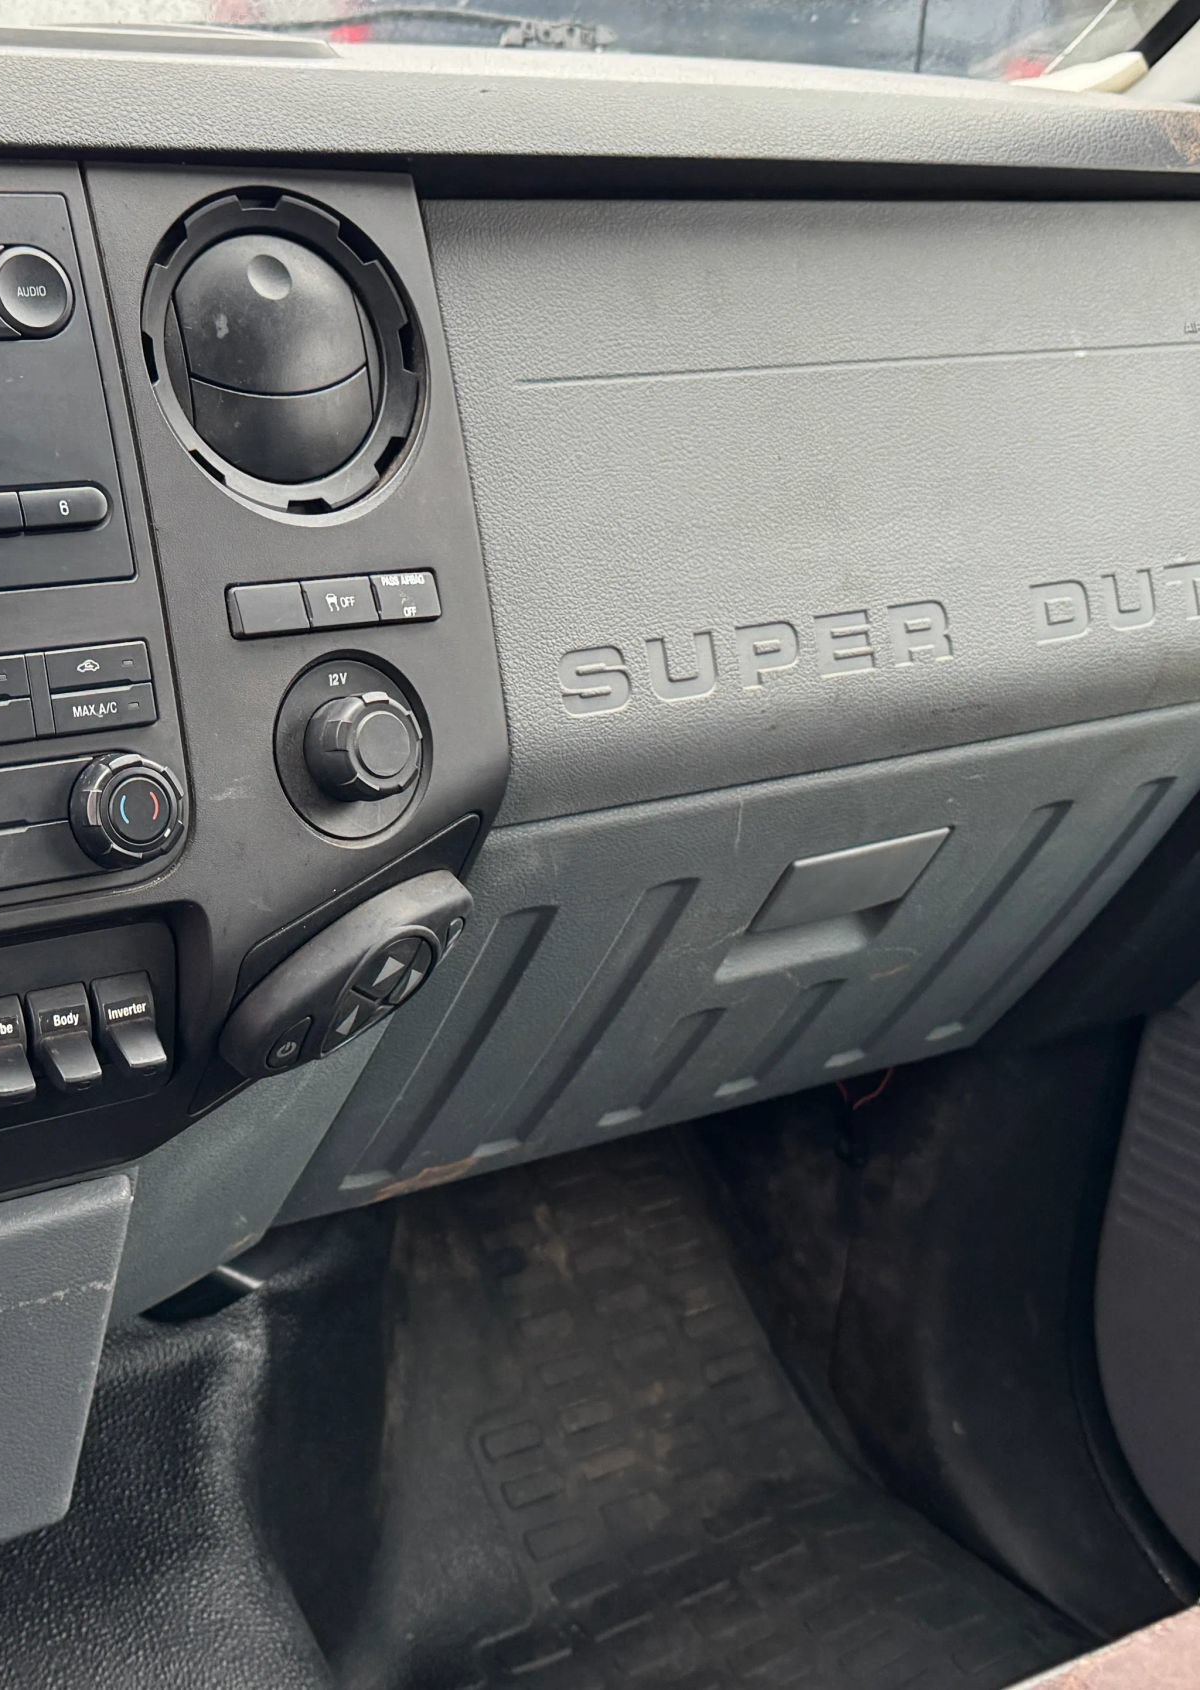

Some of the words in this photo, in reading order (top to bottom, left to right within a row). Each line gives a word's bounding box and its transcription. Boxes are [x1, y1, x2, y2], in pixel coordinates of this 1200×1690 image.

[17, 285, 46, 297] AUDIO
[59, 500, 70, 516] 6
[339, 596, 356, 607] OFF
[403, 606, 417, 617] OFF
[557, 600, 955, 717] SUPER
[328, 672, 348, 687] 12V
[72, 704, 98, 718] MAX
[98, 701, 118, 717] A/C
[108, 1002, 147, 1019] Inverter
[53, 1012, 79, 1027] Body
